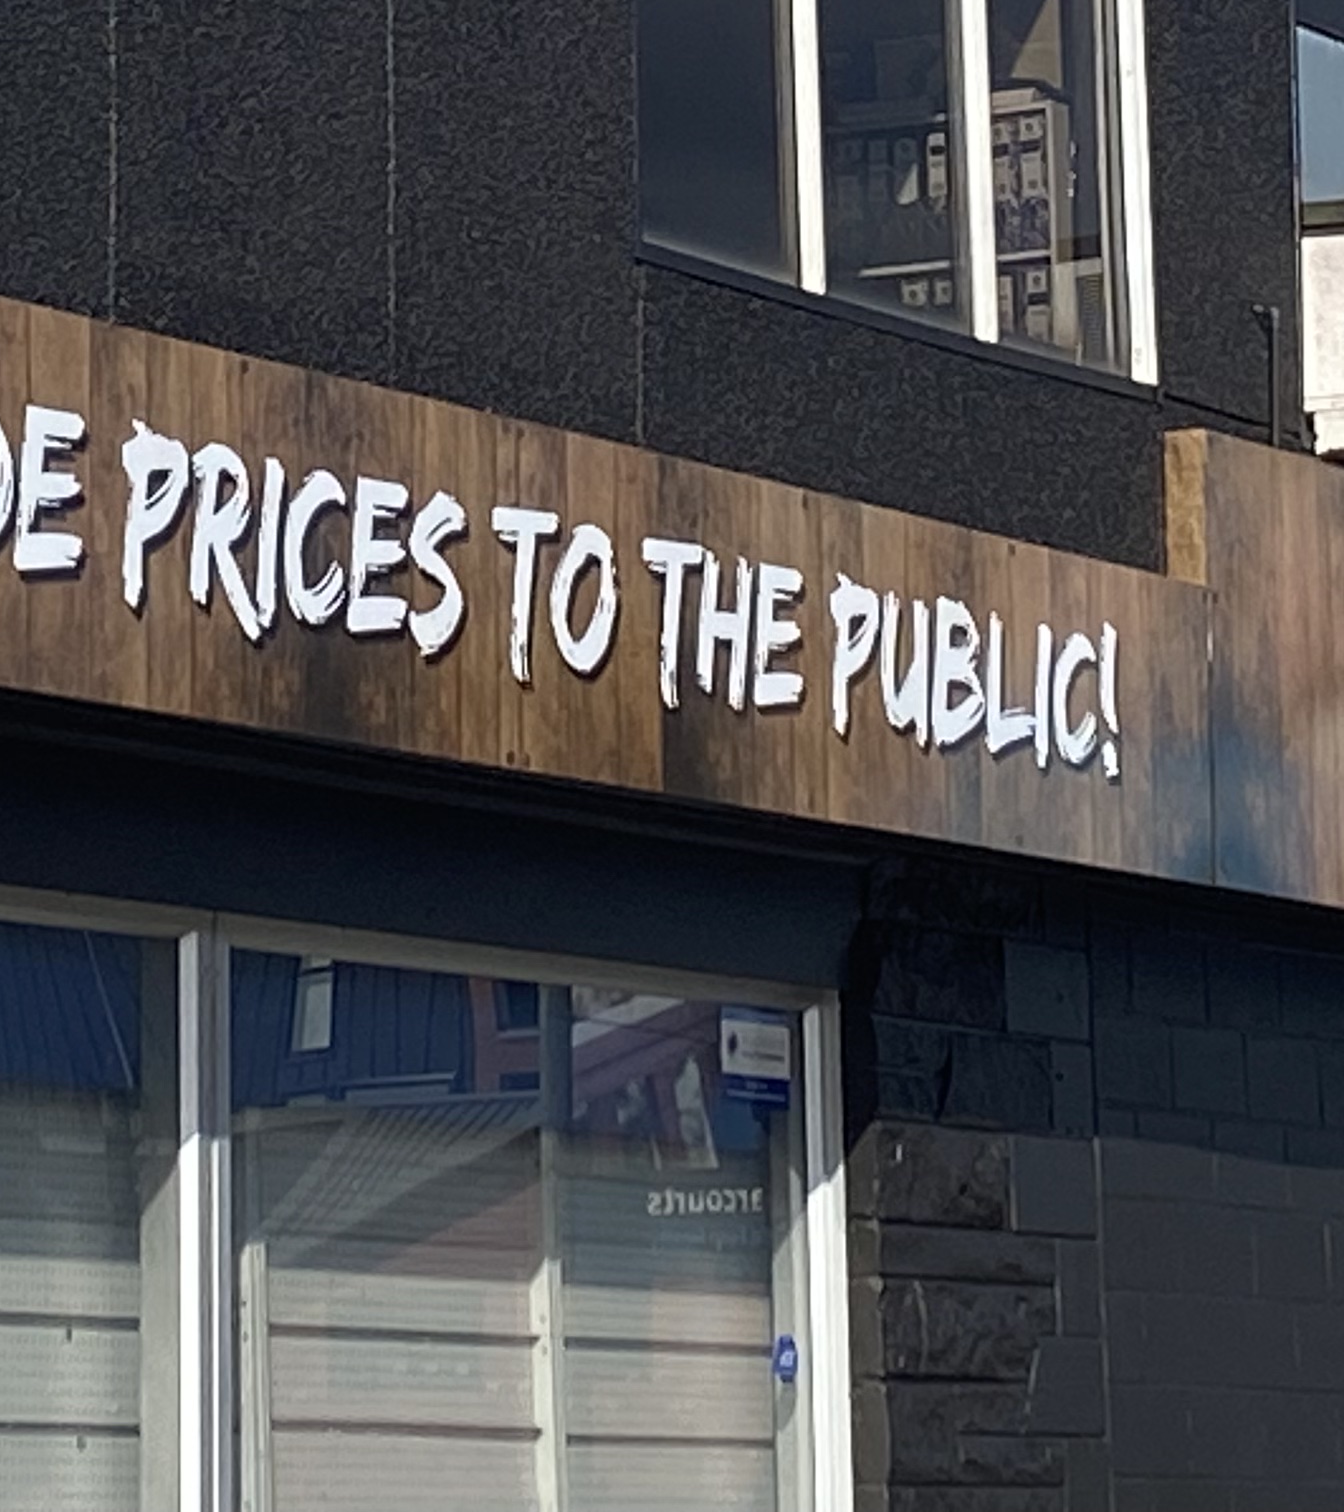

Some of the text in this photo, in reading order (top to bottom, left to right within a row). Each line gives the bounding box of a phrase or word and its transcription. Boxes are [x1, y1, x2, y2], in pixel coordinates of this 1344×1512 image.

[120, 418, 468, 659] PRICES
[491, 506, 617, 685] TO
[641, 537, 805, 712] THE
[829, 571, 1121, 779] PUBLIC!
